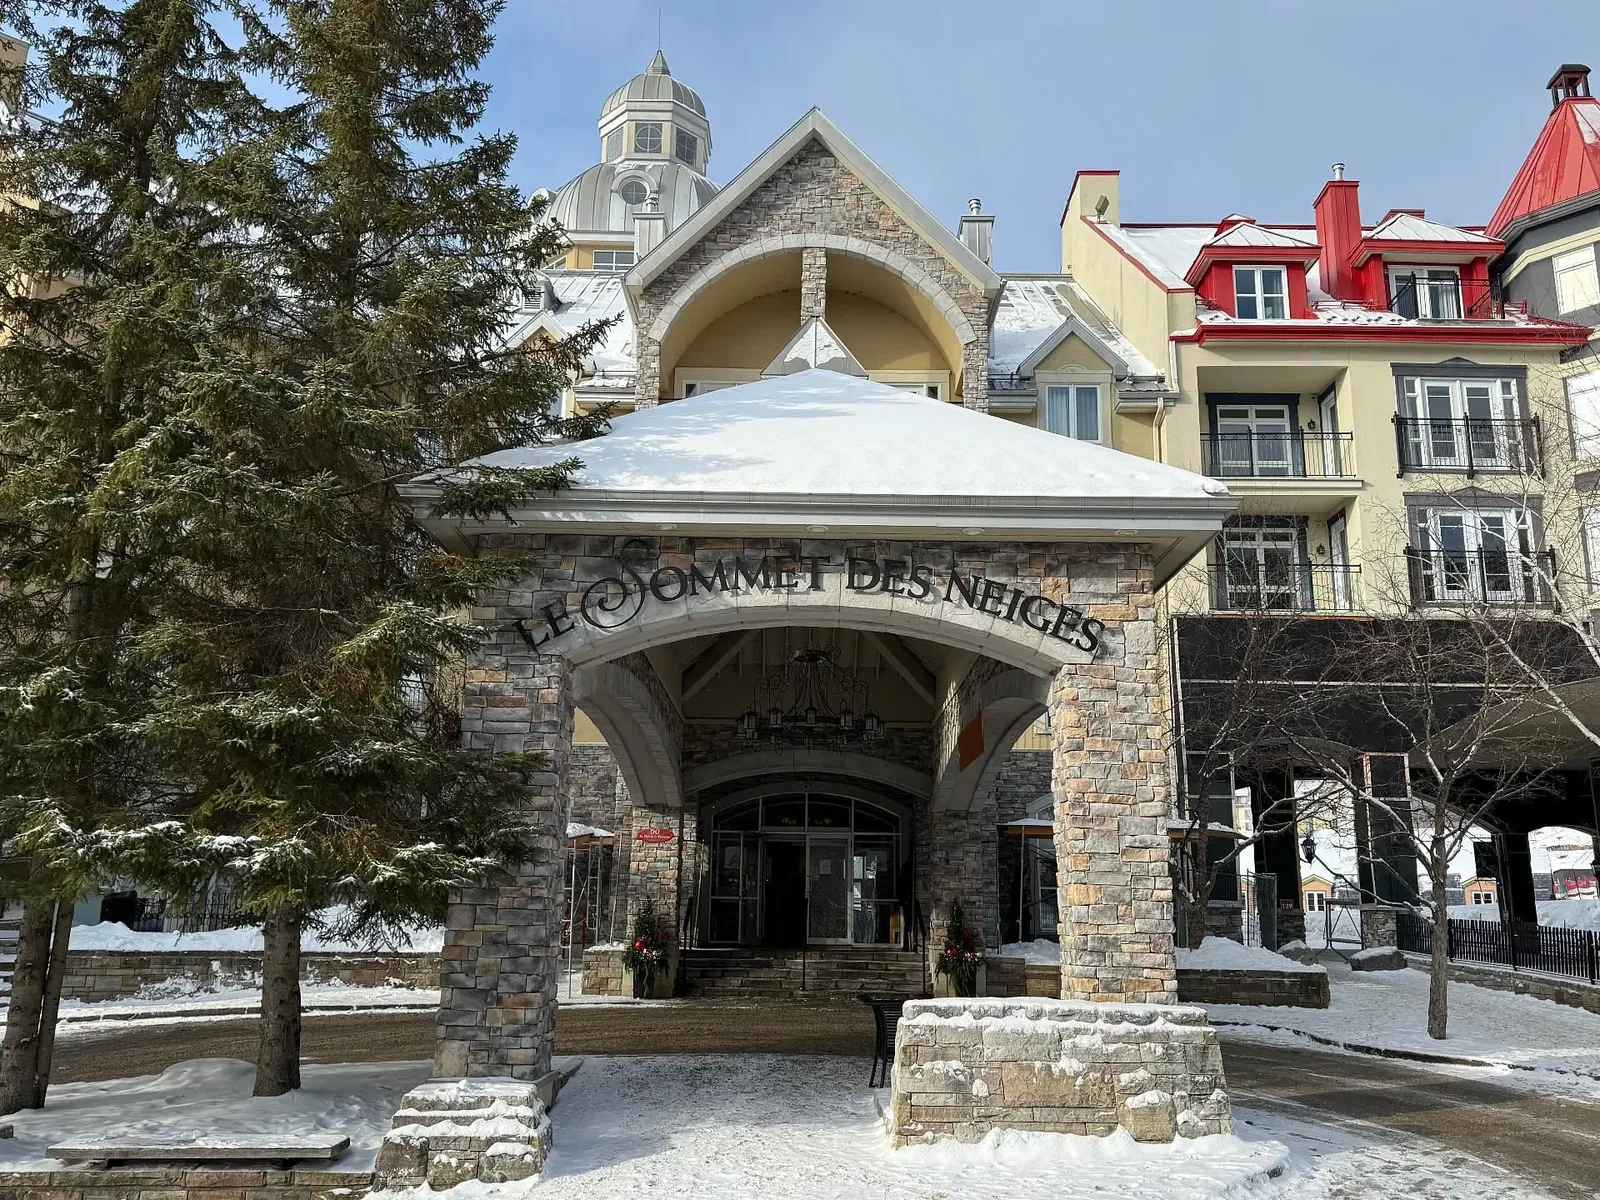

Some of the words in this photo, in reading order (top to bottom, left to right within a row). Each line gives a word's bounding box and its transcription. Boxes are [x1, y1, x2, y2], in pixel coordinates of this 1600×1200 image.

[513, 599, 575, 650] LE
[580, 538, 830, 629] SOMMET
[846, 556, 933, 599] DES
[942, 568, 1106, 651] NEIGES
